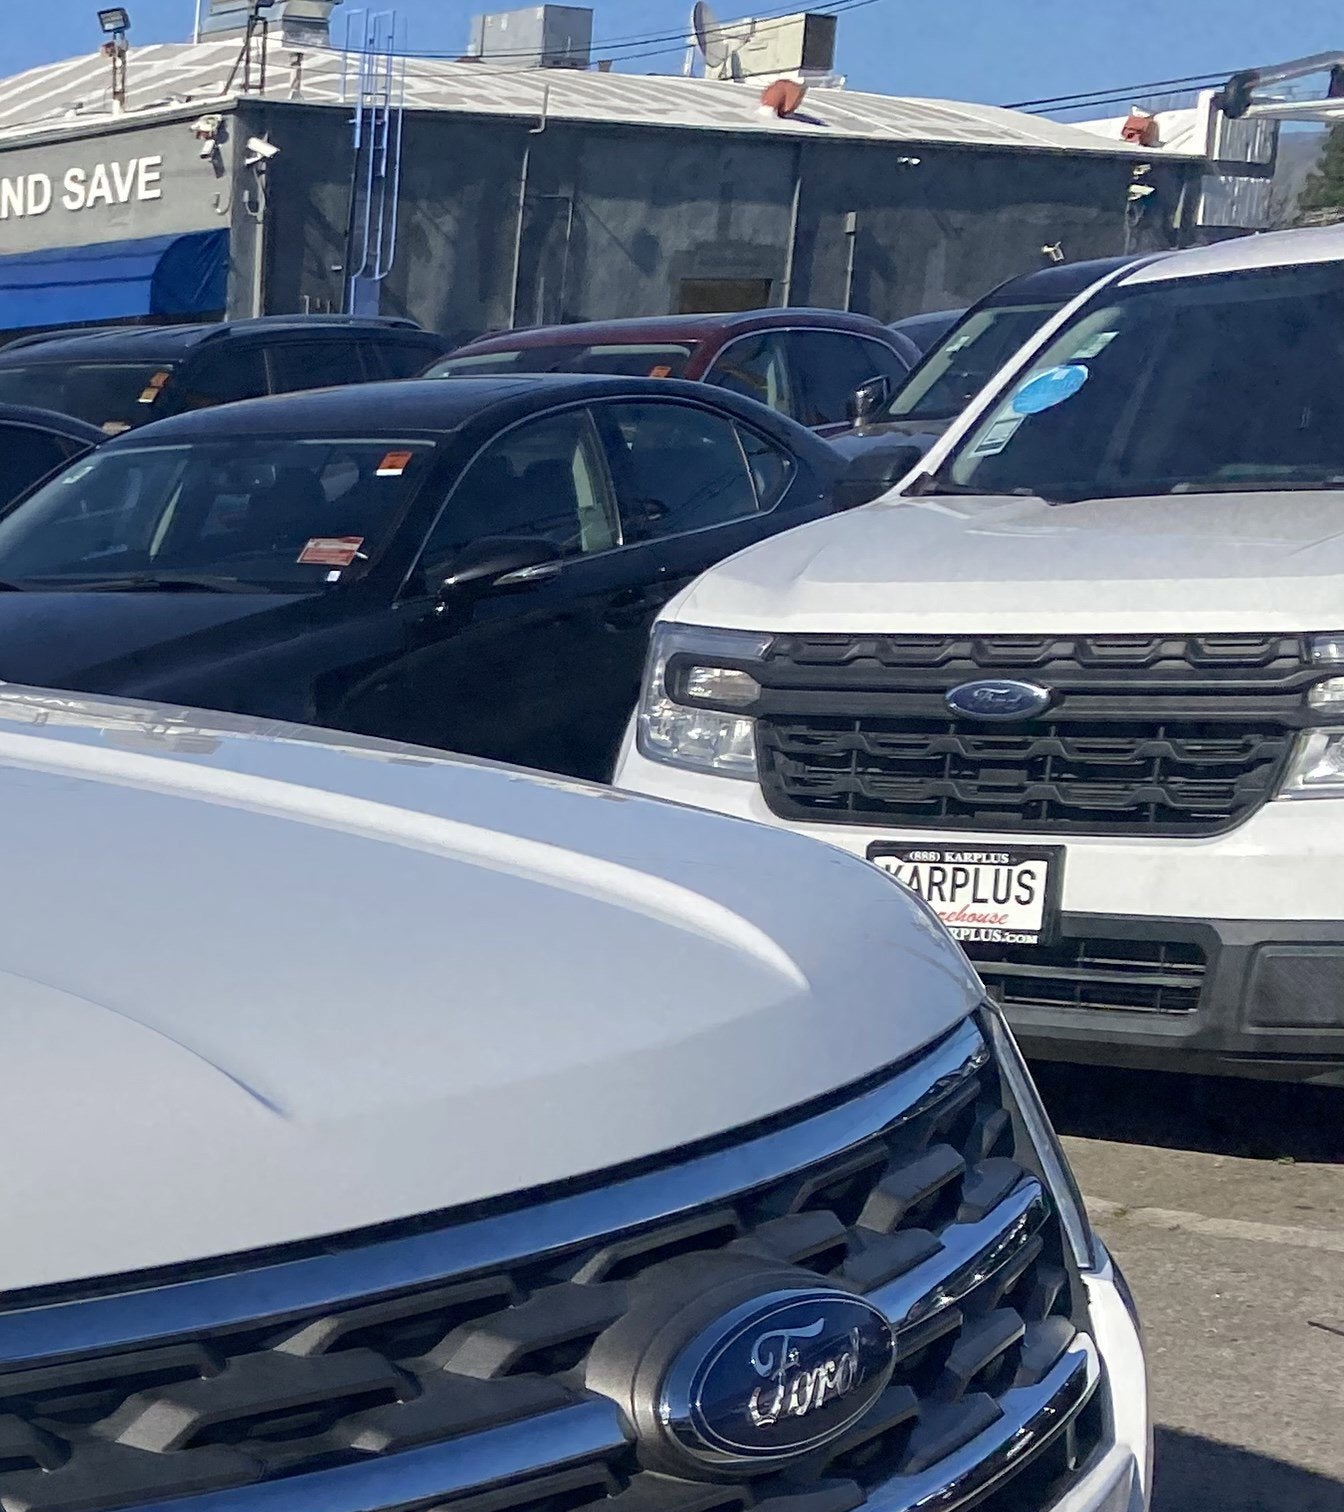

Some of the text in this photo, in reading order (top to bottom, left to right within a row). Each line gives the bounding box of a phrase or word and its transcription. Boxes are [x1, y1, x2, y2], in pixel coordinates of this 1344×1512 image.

[62, 155, 161, 210] SAVE
[909, 851, 1010, 863] (888) KARPLUS
[746, 1317, 861, 1427] Ford
